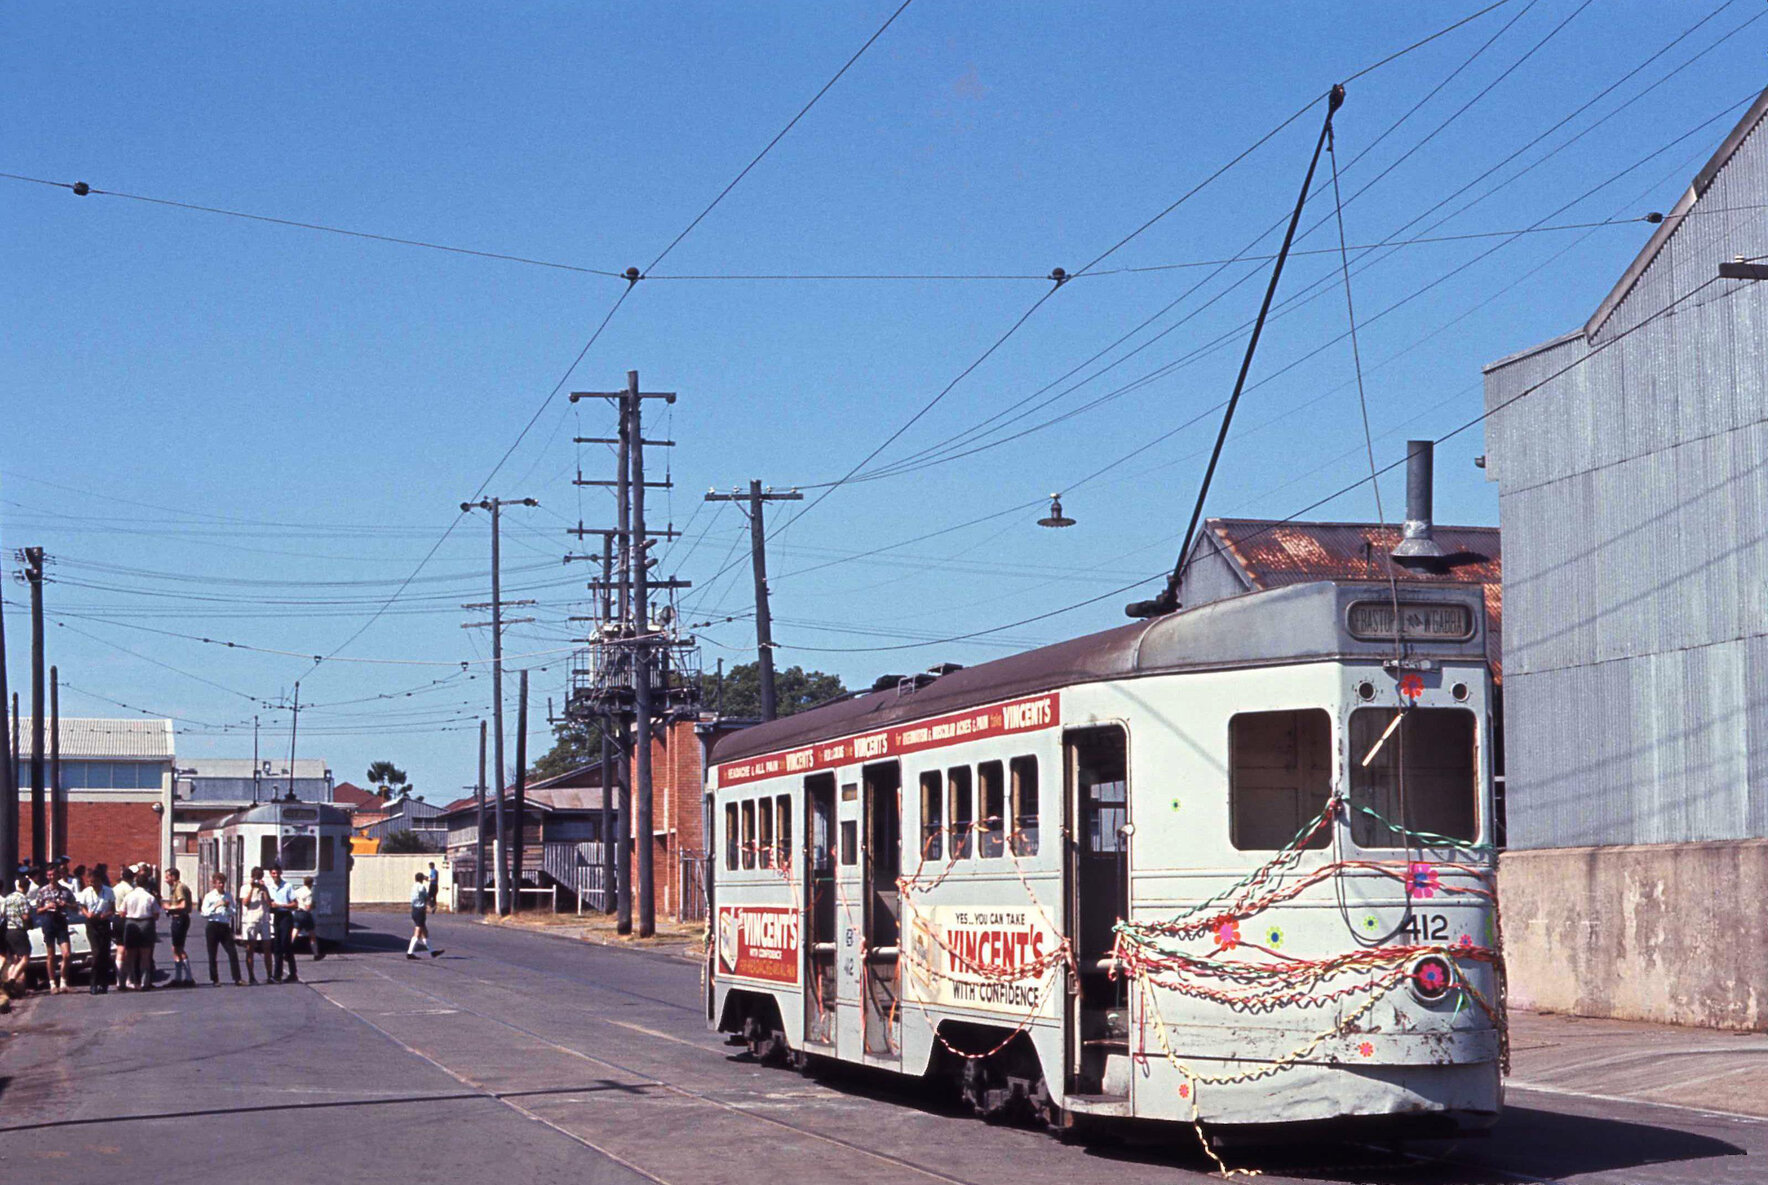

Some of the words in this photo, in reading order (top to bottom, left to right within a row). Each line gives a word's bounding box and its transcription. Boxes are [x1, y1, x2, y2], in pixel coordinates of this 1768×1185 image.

[1002, 698, 1051, 730] VINCENT'S
[854, 733, 888, 758] VINCENT'S
[755, 763, 765, 775] ALL
[766, 760, 778, 772] PAIN
[786, 749, 814, 772] VINCENT'S
[744, 908, 798, 950] VINCENT'S
[990, 913, 1004, 925] CAN
[1006, 913, 1025, 926] TAKE
[1400, 914, 1448, 940] 412
[947, 924, 1044, 979] VINCENT'S
[952, 980, 976, 1000] WITH
[980, 982, 1039, 1008] CONFIDENCE
